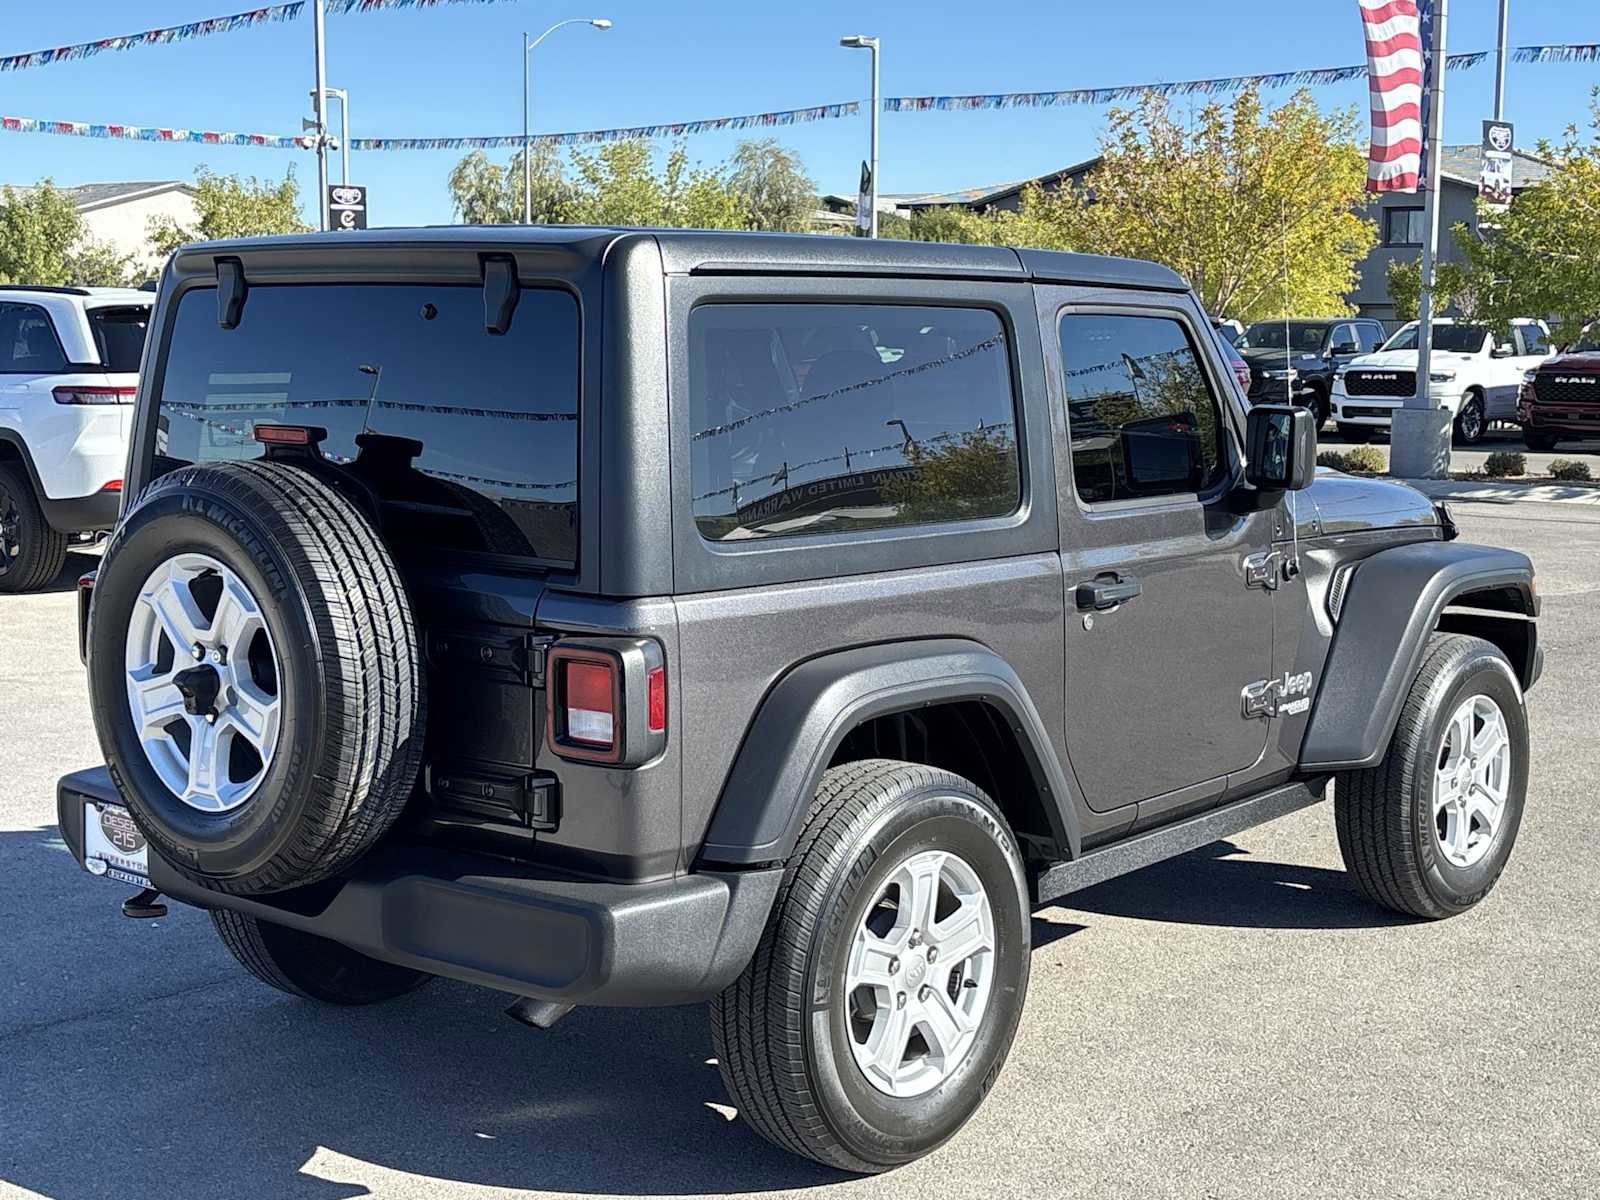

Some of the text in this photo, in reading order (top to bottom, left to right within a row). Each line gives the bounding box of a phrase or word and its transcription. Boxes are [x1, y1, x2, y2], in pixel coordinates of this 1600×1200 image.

[206, 503, 286, 590] MICHELIN
[1279, 671, 1313, 697] Jeep
[1417, 750, 1434, 846] MICHELIN
[112, 828, 136, 849] 215
